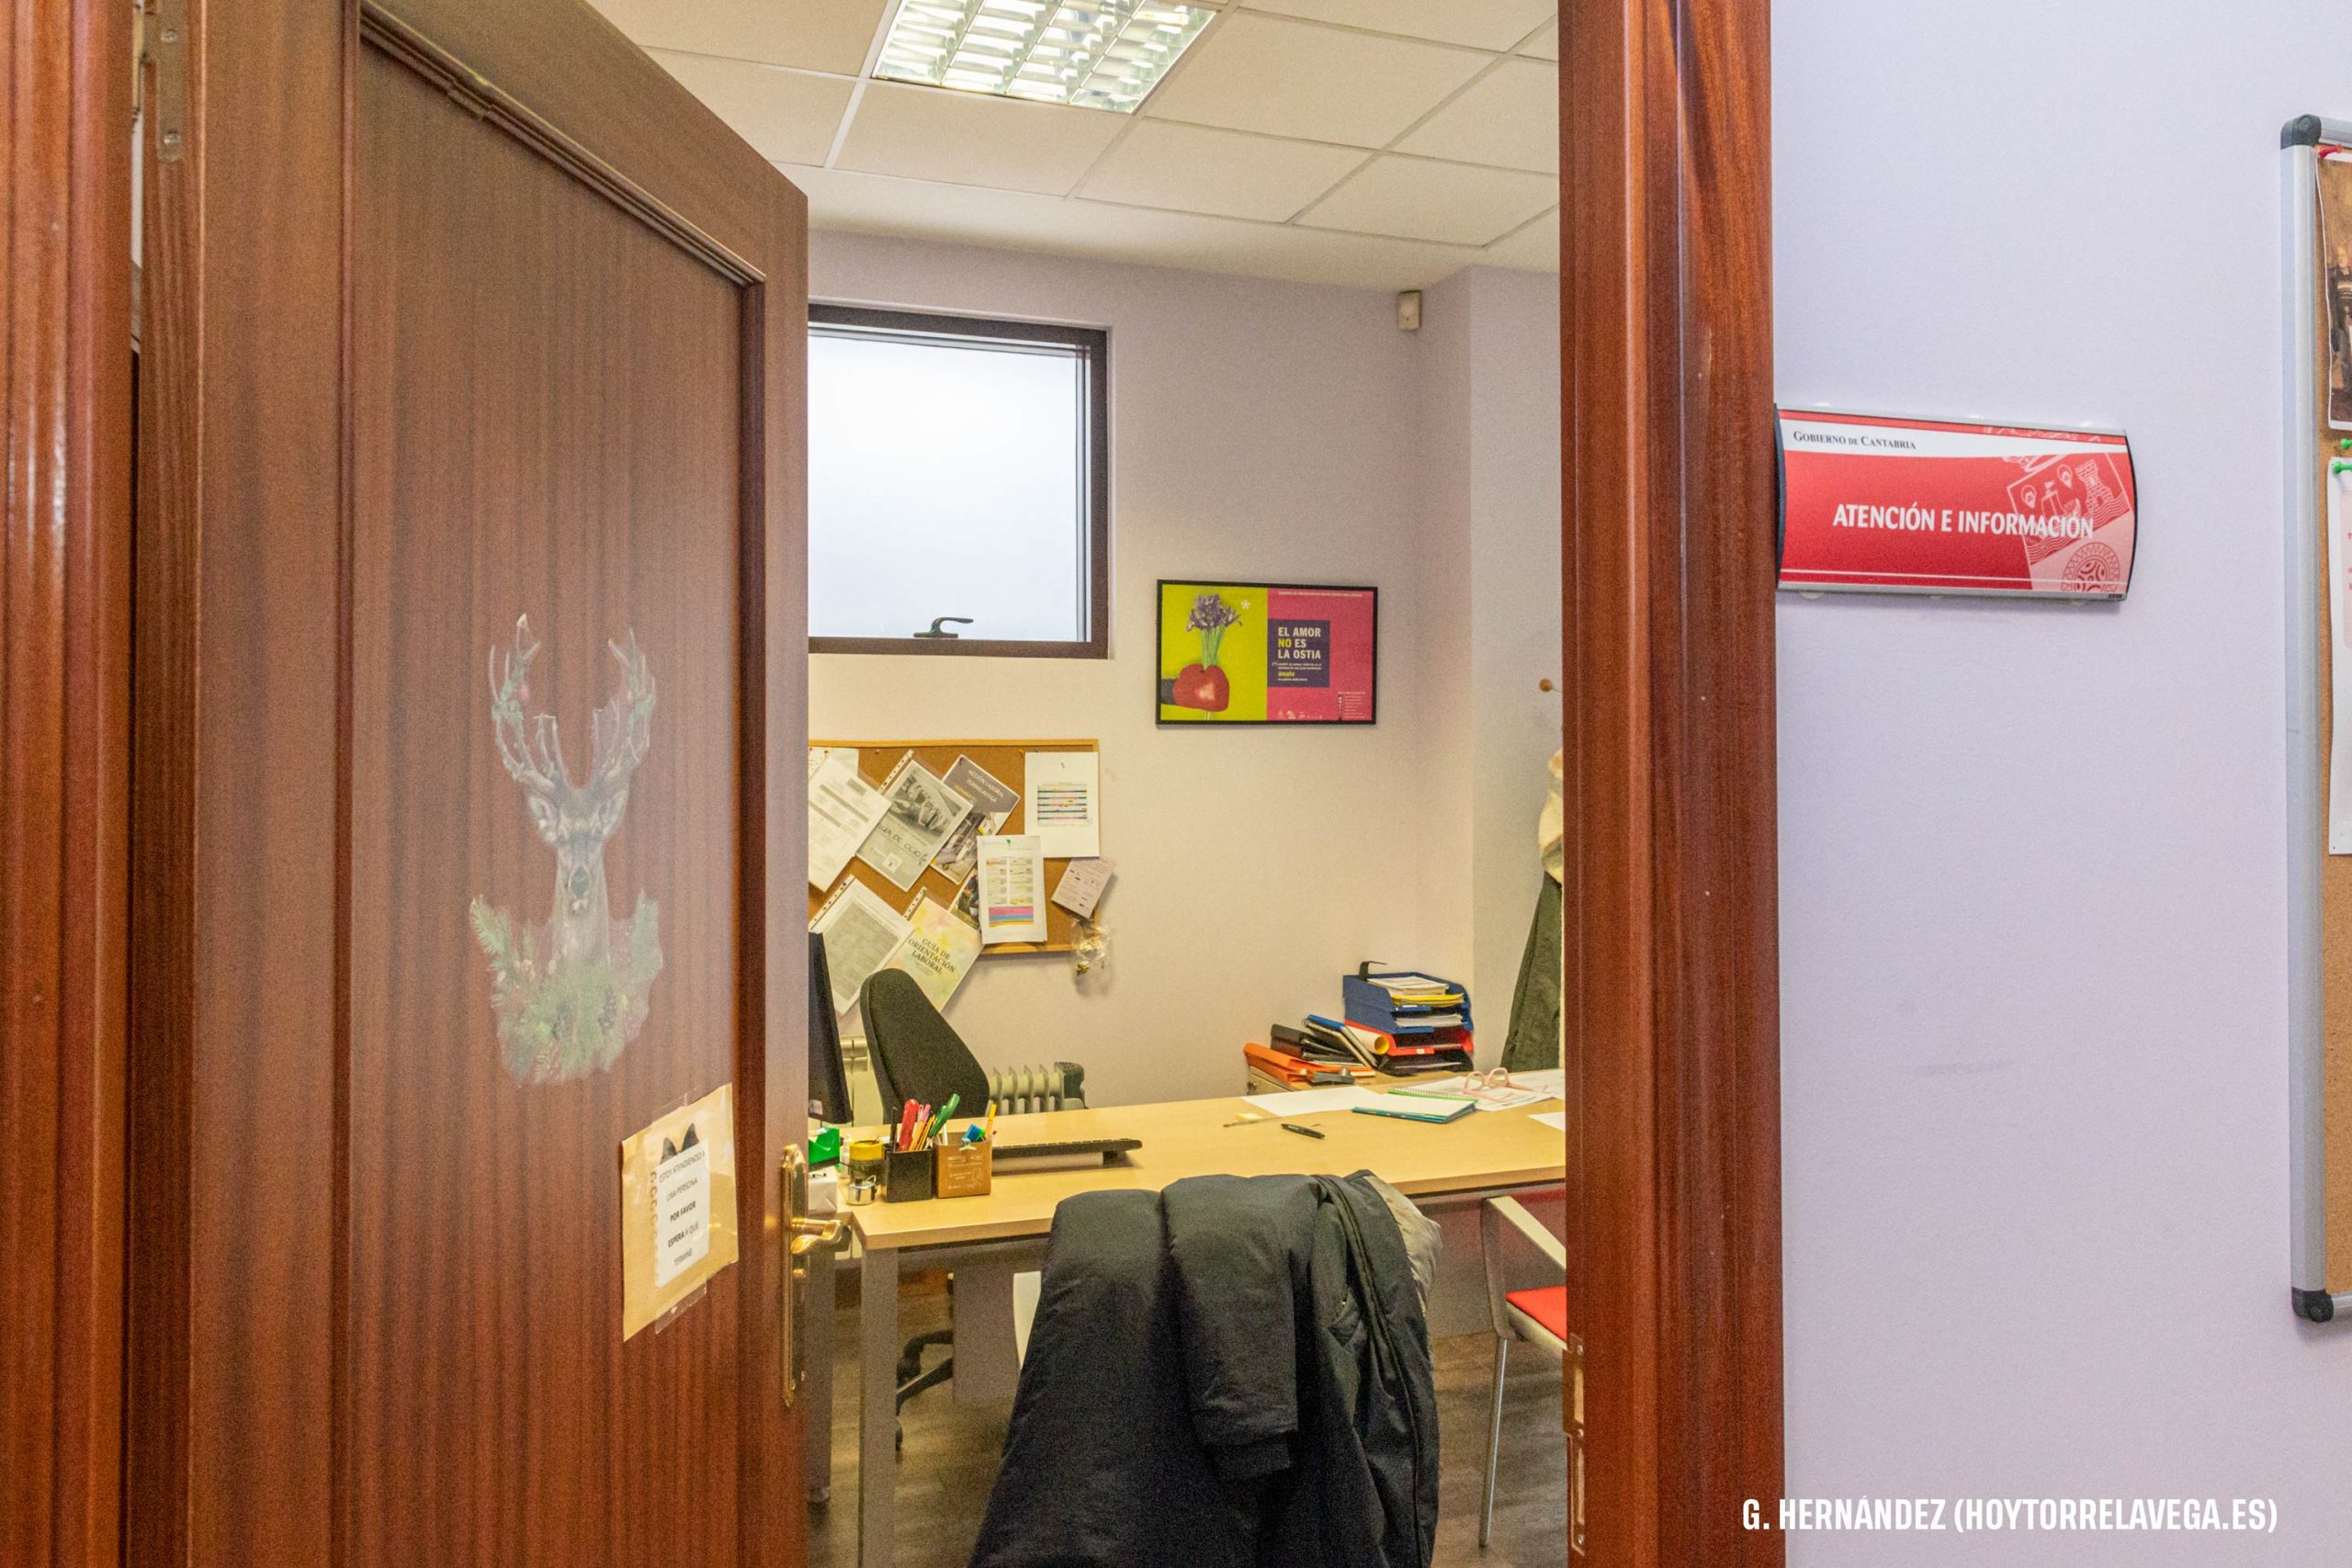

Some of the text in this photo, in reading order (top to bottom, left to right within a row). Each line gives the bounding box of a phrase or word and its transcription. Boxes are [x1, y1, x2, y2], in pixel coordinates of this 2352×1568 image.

[1793, 430, 1847, 445] GOBIERNO
[1860, 435, 1917, 450] CANTABRIA
[1832, 501, 2094, 539] ATENCIÓN E INFORMACIÓN
[1278, 626, 1321, 637] EL AMOR
[1278, 637, 1306, 649] NO ES
[1278, 649, 1321, 660] LA OSTIA
[908, 938, 956, 973] ORIENTACIÓN
[911, 950, 943, 975] LABORAL
[940, 949, 951, 961] DE
[670, 1201, 695, 1223] POR FAVOR
[668, 1231, 684, 1247] ESPERA
